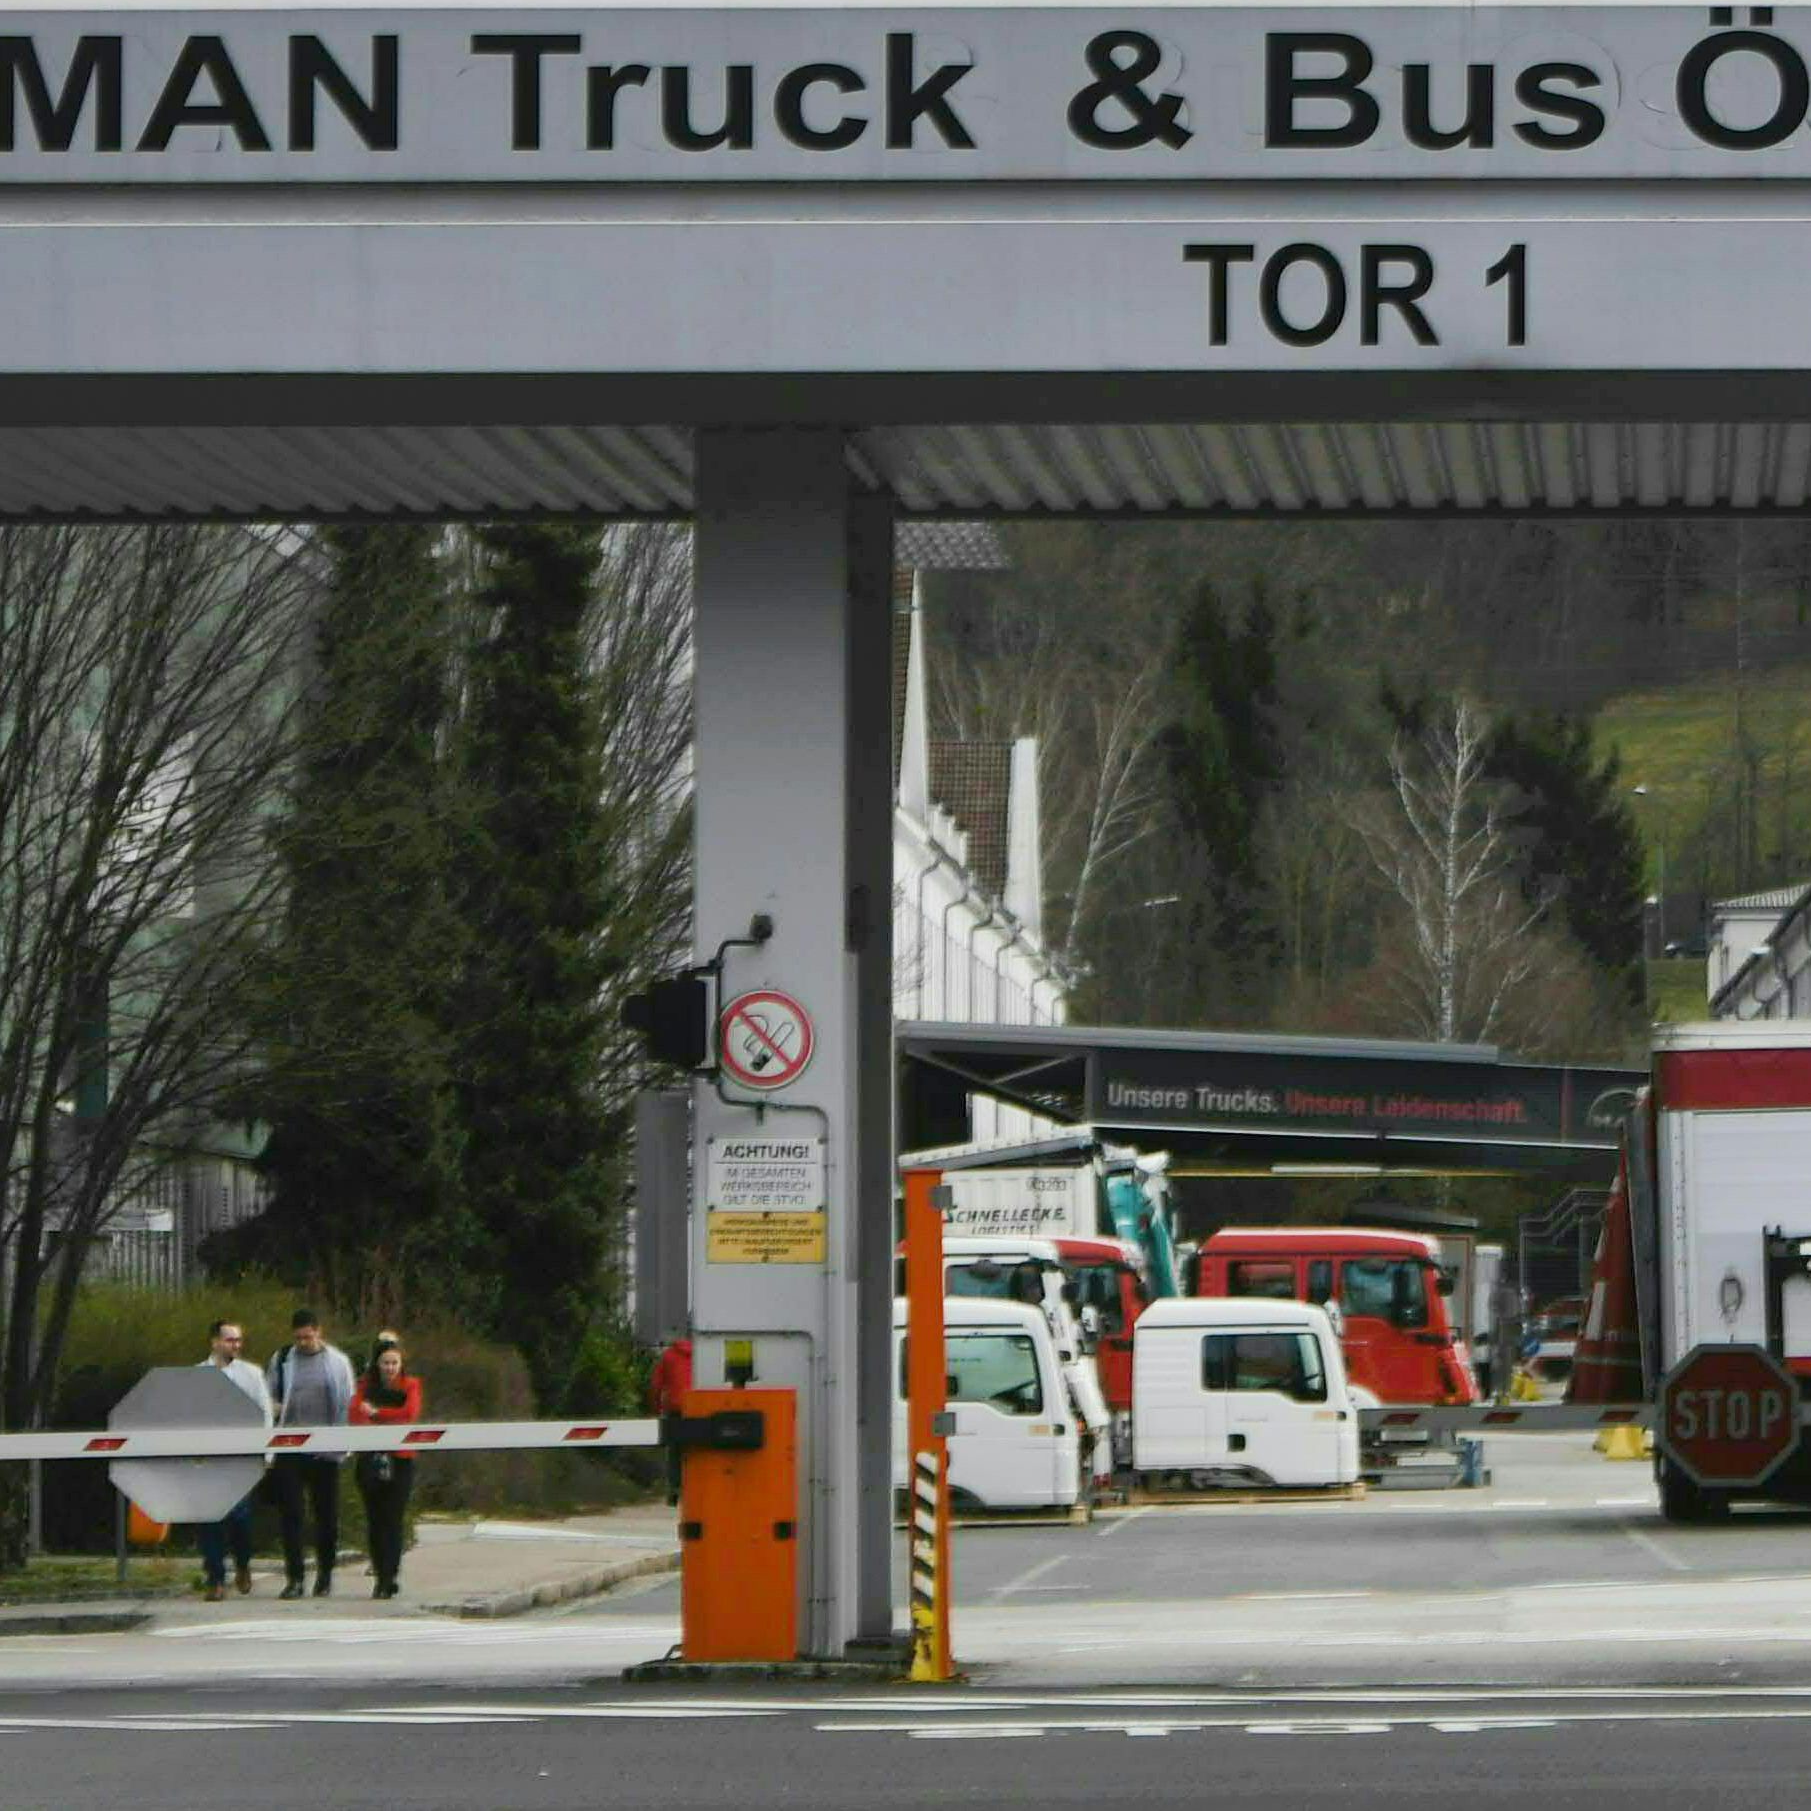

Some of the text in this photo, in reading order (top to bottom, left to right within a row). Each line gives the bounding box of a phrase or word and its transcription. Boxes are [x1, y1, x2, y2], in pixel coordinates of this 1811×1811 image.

[0, 33, 401, 153] MAN
[470, 31, 978, 152] Truck
[1066, 28, 1195, 151] &
[1264, 31, 1607, 151] Bus
[1183, 241, 1528, 348] TOR 1
[1107, 1082, 1189, 1109] Unsere
[1195, 1085, 1279, 1113] Trucks.
[1286, 1089, 1367, 1117] Unsere
[722, 1145, 810, 1159] ACHTUNG!
[1674, 1390, 1784, 1439] STOP
